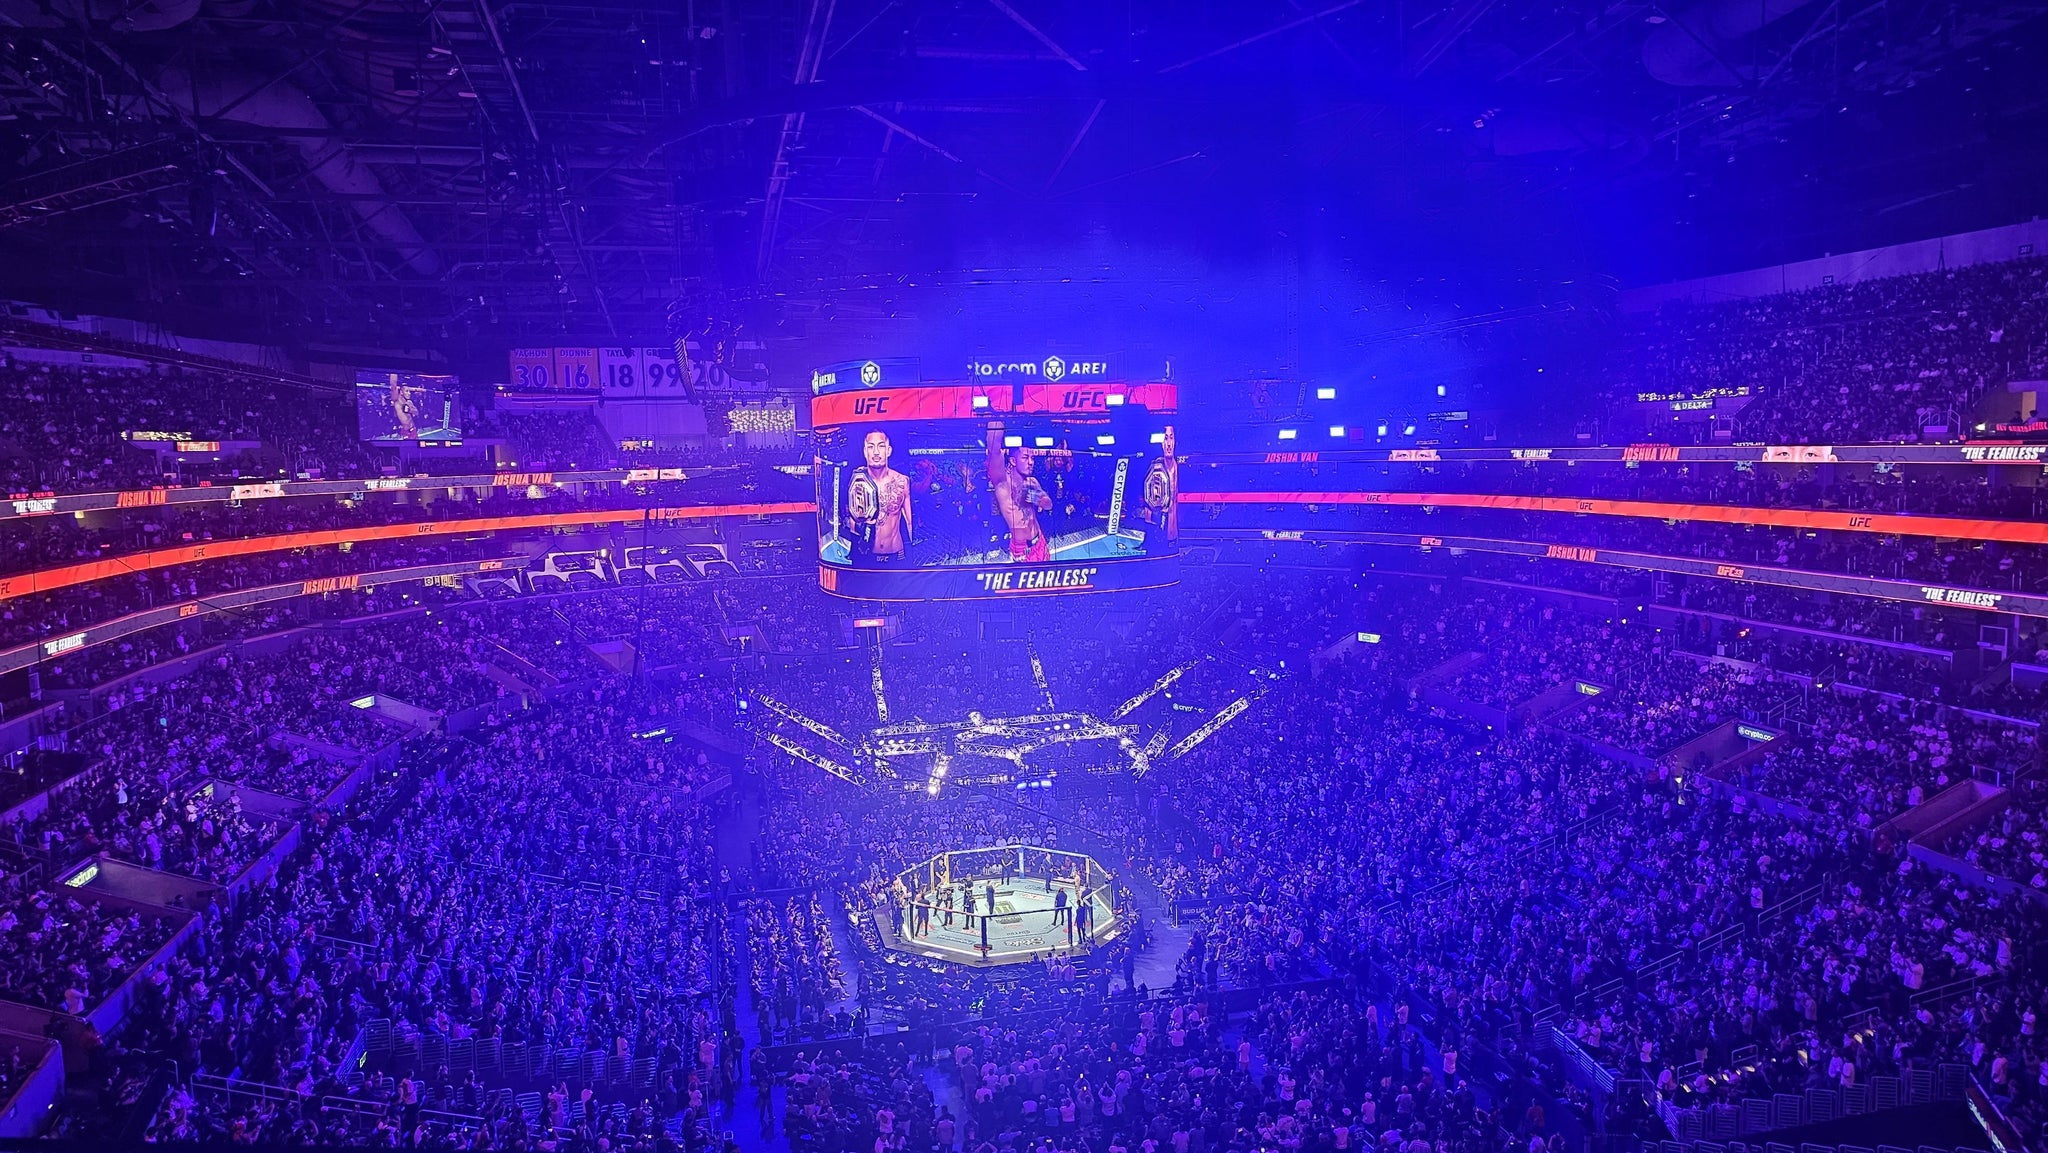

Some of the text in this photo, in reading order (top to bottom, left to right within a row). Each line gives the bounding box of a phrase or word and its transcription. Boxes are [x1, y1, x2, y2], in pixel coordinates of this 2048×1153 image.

[560, 349, 592, 358] DIONNE
[606, 349, 635, 358] TAYLR
[649, 363, 680, 387] 99
[968, 361, 1038, 376] to.com
[514, 364, 548, 388] 30
[564, 364, 590, 388] 16
[608, 364, 634, 388] 18
[854, 396, 890, 414] UFC
[1063, 391, 1104, 409] UFC
[1682, 401, 1708, 410] DELTA
[1264, 452, 1319, 463] JOSHUA VAN
[1622, 448, 1680, 461] JOSHUA VAN
[1961, 447, 2046, 460] "THE FEARLESS"
[492, 473, 552, 486] JOSHUA VAN
[117, 490, 167, 507] JOSHUA VAN
[1108, 474, 1125, 533] crypto.com
[1366, 494, 1381, 502] UFC
[1579, 502, 1593, 511] UFC
[667, 510, 681, 518] UFC
[418, 525, 435, 533] UFC
[1849, 517, 1872, 528] UFC
[1420, 537, 1443, 546] UFC
[193, 548, 206, 558] UFC
[1546, 545, 1597, 562] JOSHUA VAN
[479, 561, 503, 570] UFC
[302, 575, 359, 595] JOSHUA VAN
[976, 568, 1097, 590] "THE FEARLESS"
[0, 582, 11, 594] FC
[1921, 587, 2002, 608] "THE FEARLESS"
[179, 604, 199, 617] UFC
